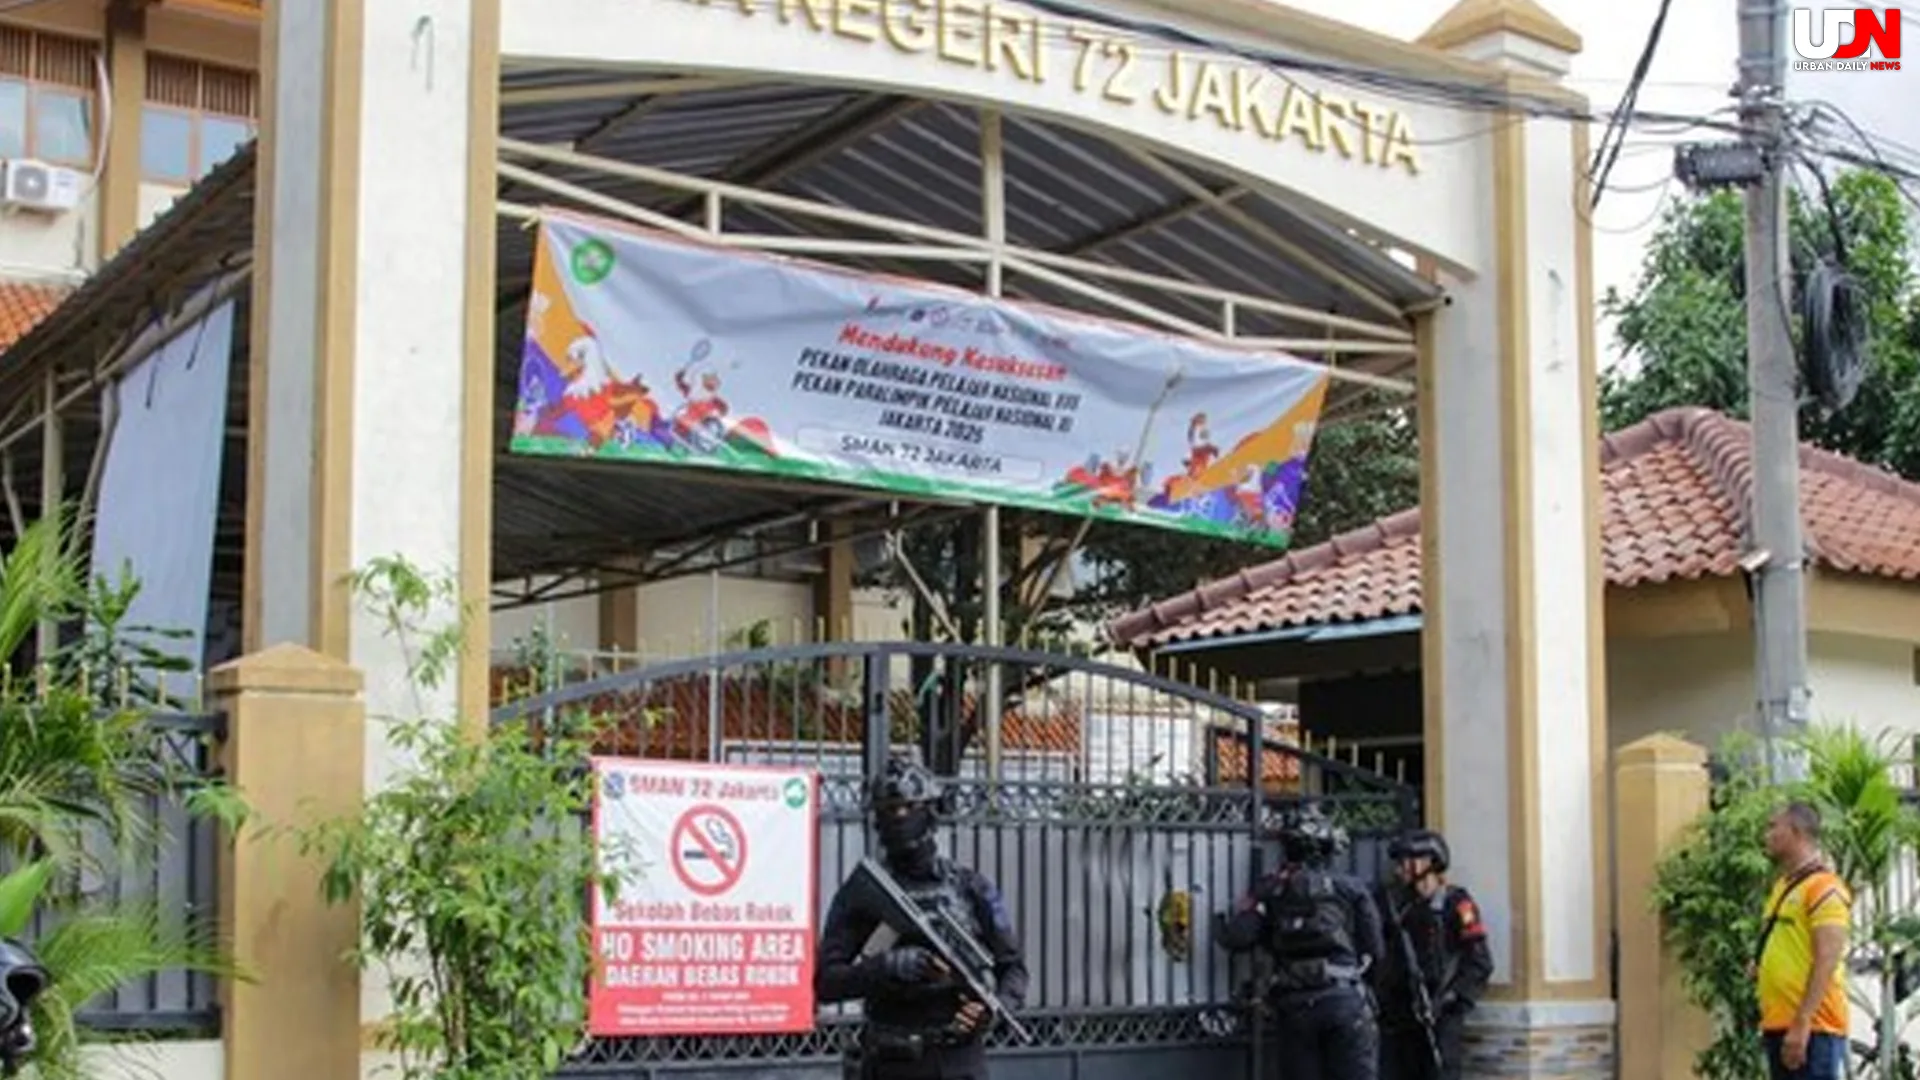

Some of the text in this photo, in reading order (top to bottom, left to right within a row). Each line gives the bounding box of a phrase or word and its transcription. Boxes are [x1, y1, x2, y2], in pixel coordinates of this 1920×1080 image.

[1065, 25, 1138, 105] 72
[1153, 50, 1421, 177] JAKARTA
[798, 346, 851, 372] PEKAN
[792, 370, 843, 394] PEKAN
[878, 408, 985, 444] JAKARTA 2025
[841, 433, 1002, 474] SMAN 72 JAKARTA
[629, 775, 780, 802] SMAN 72 Jakarta
[642, 932, 744, 962] SMOKING
[751, 933, 806, 962] AREA
